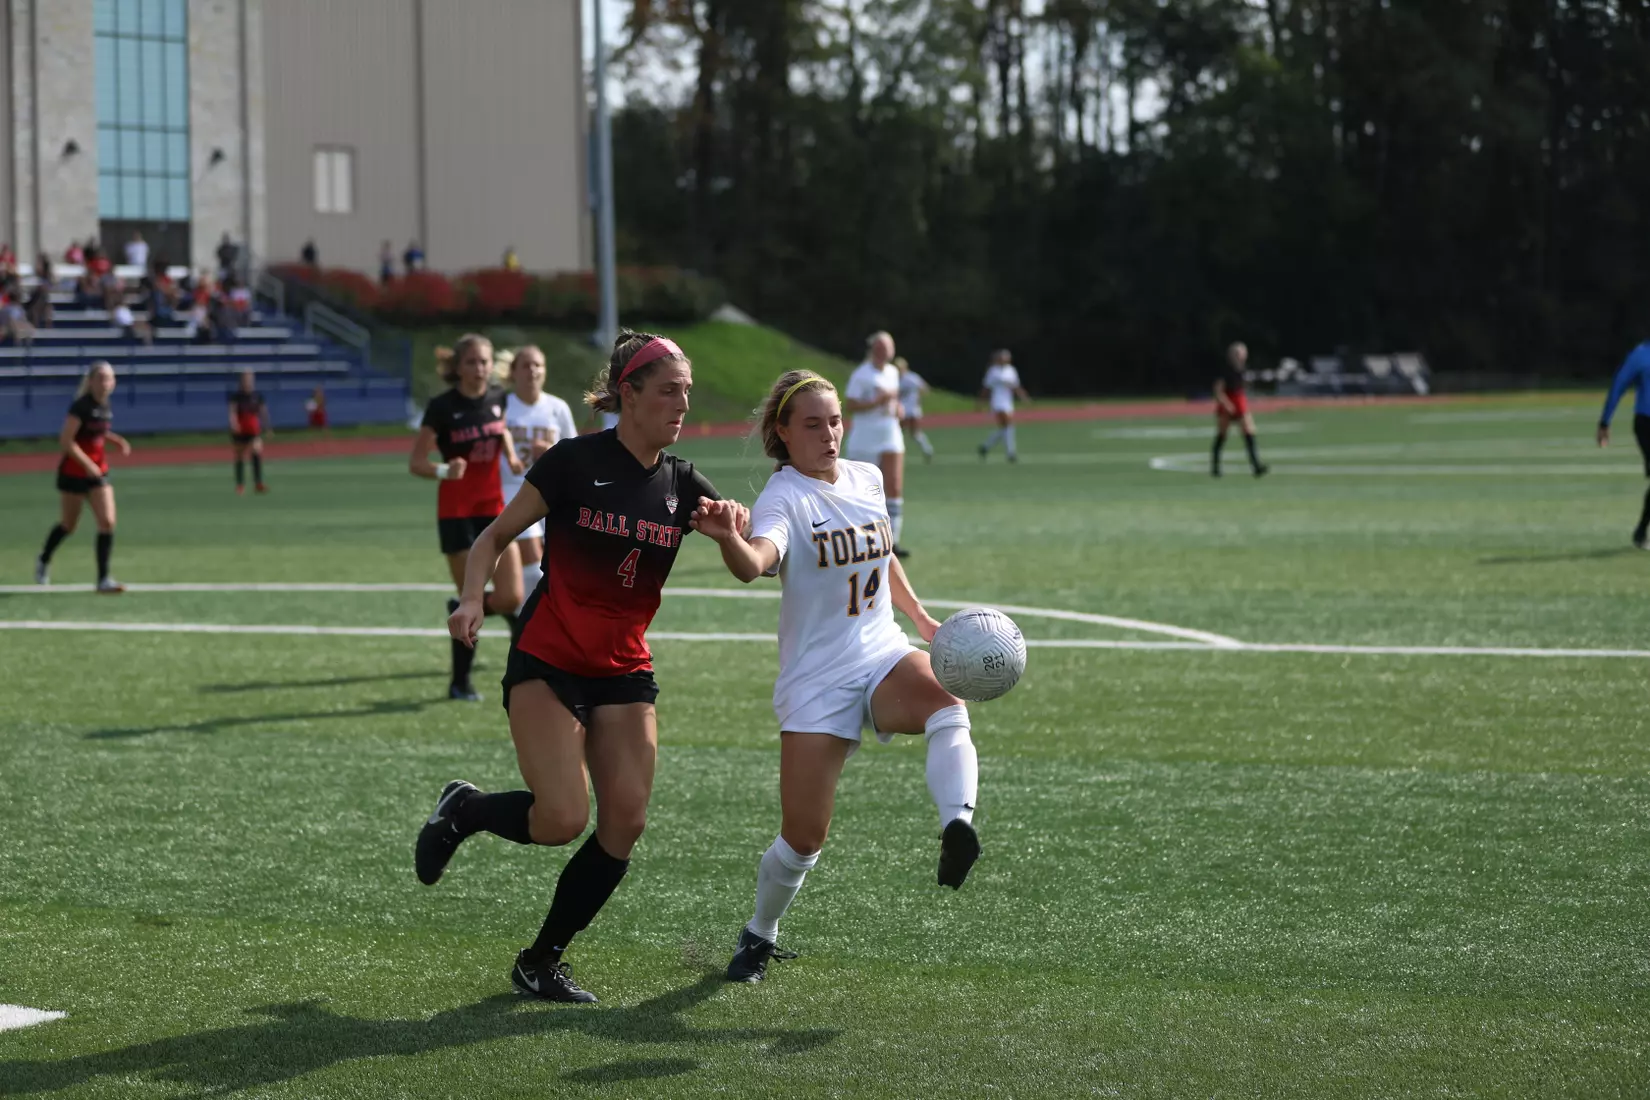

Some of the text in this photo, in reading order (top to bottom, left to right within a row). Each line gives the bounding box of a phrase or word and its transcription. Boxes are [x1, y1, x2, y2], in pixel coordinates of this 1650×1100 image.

[577, 507, 629, 537] BALL
[637, 519, 681, 547] STATE
[617, 548, 641, 588] 4
[847, 567, 880, 616] 14
